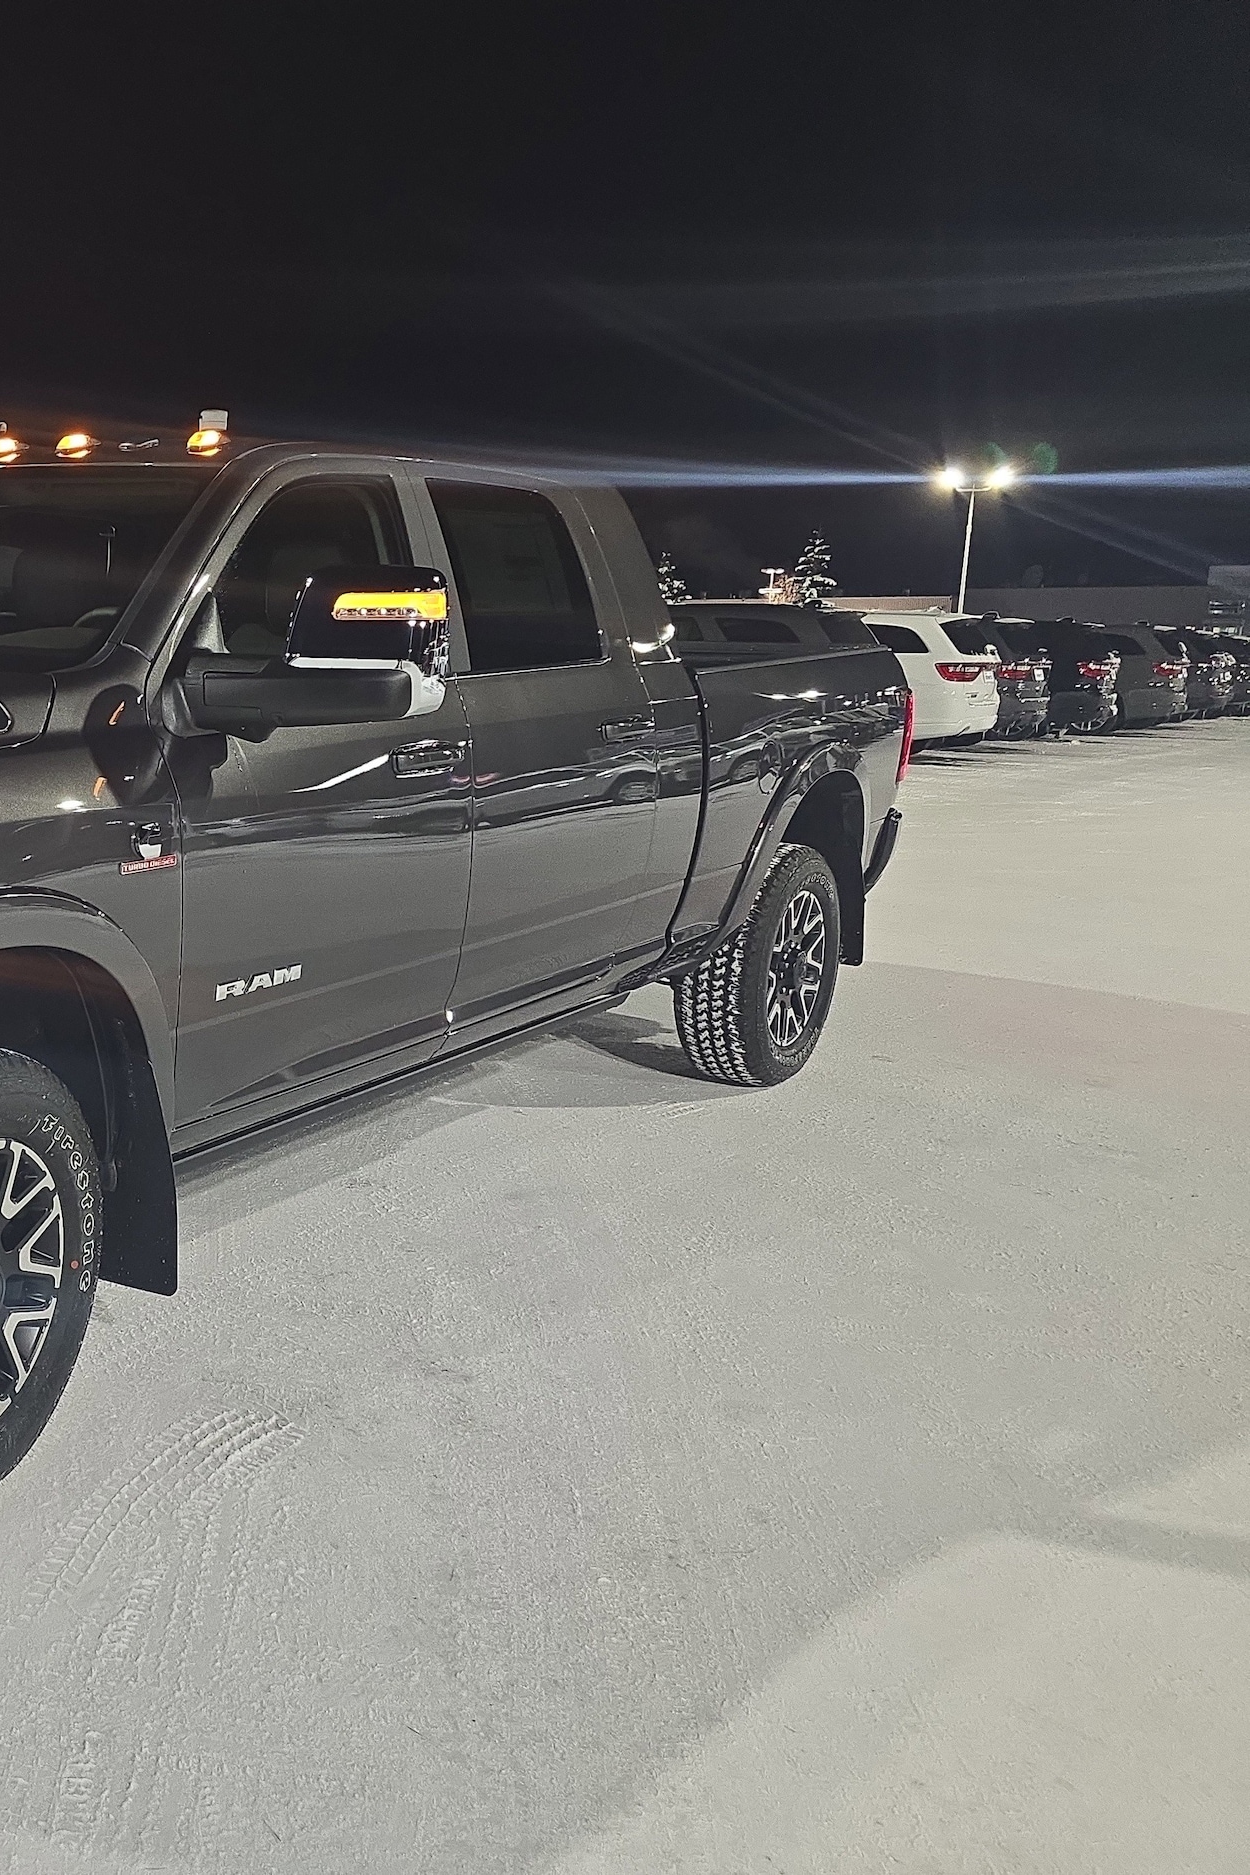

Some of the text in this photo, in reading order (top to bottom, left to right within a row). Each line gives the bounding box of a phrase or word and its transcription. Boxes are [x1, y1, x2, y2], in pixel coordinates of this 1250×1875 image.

[123, 857, 175, 872] TURBO DIESEL
[214, 963, 302, 1002] RAM
[41, 1113, 95, 1292] Firestone
